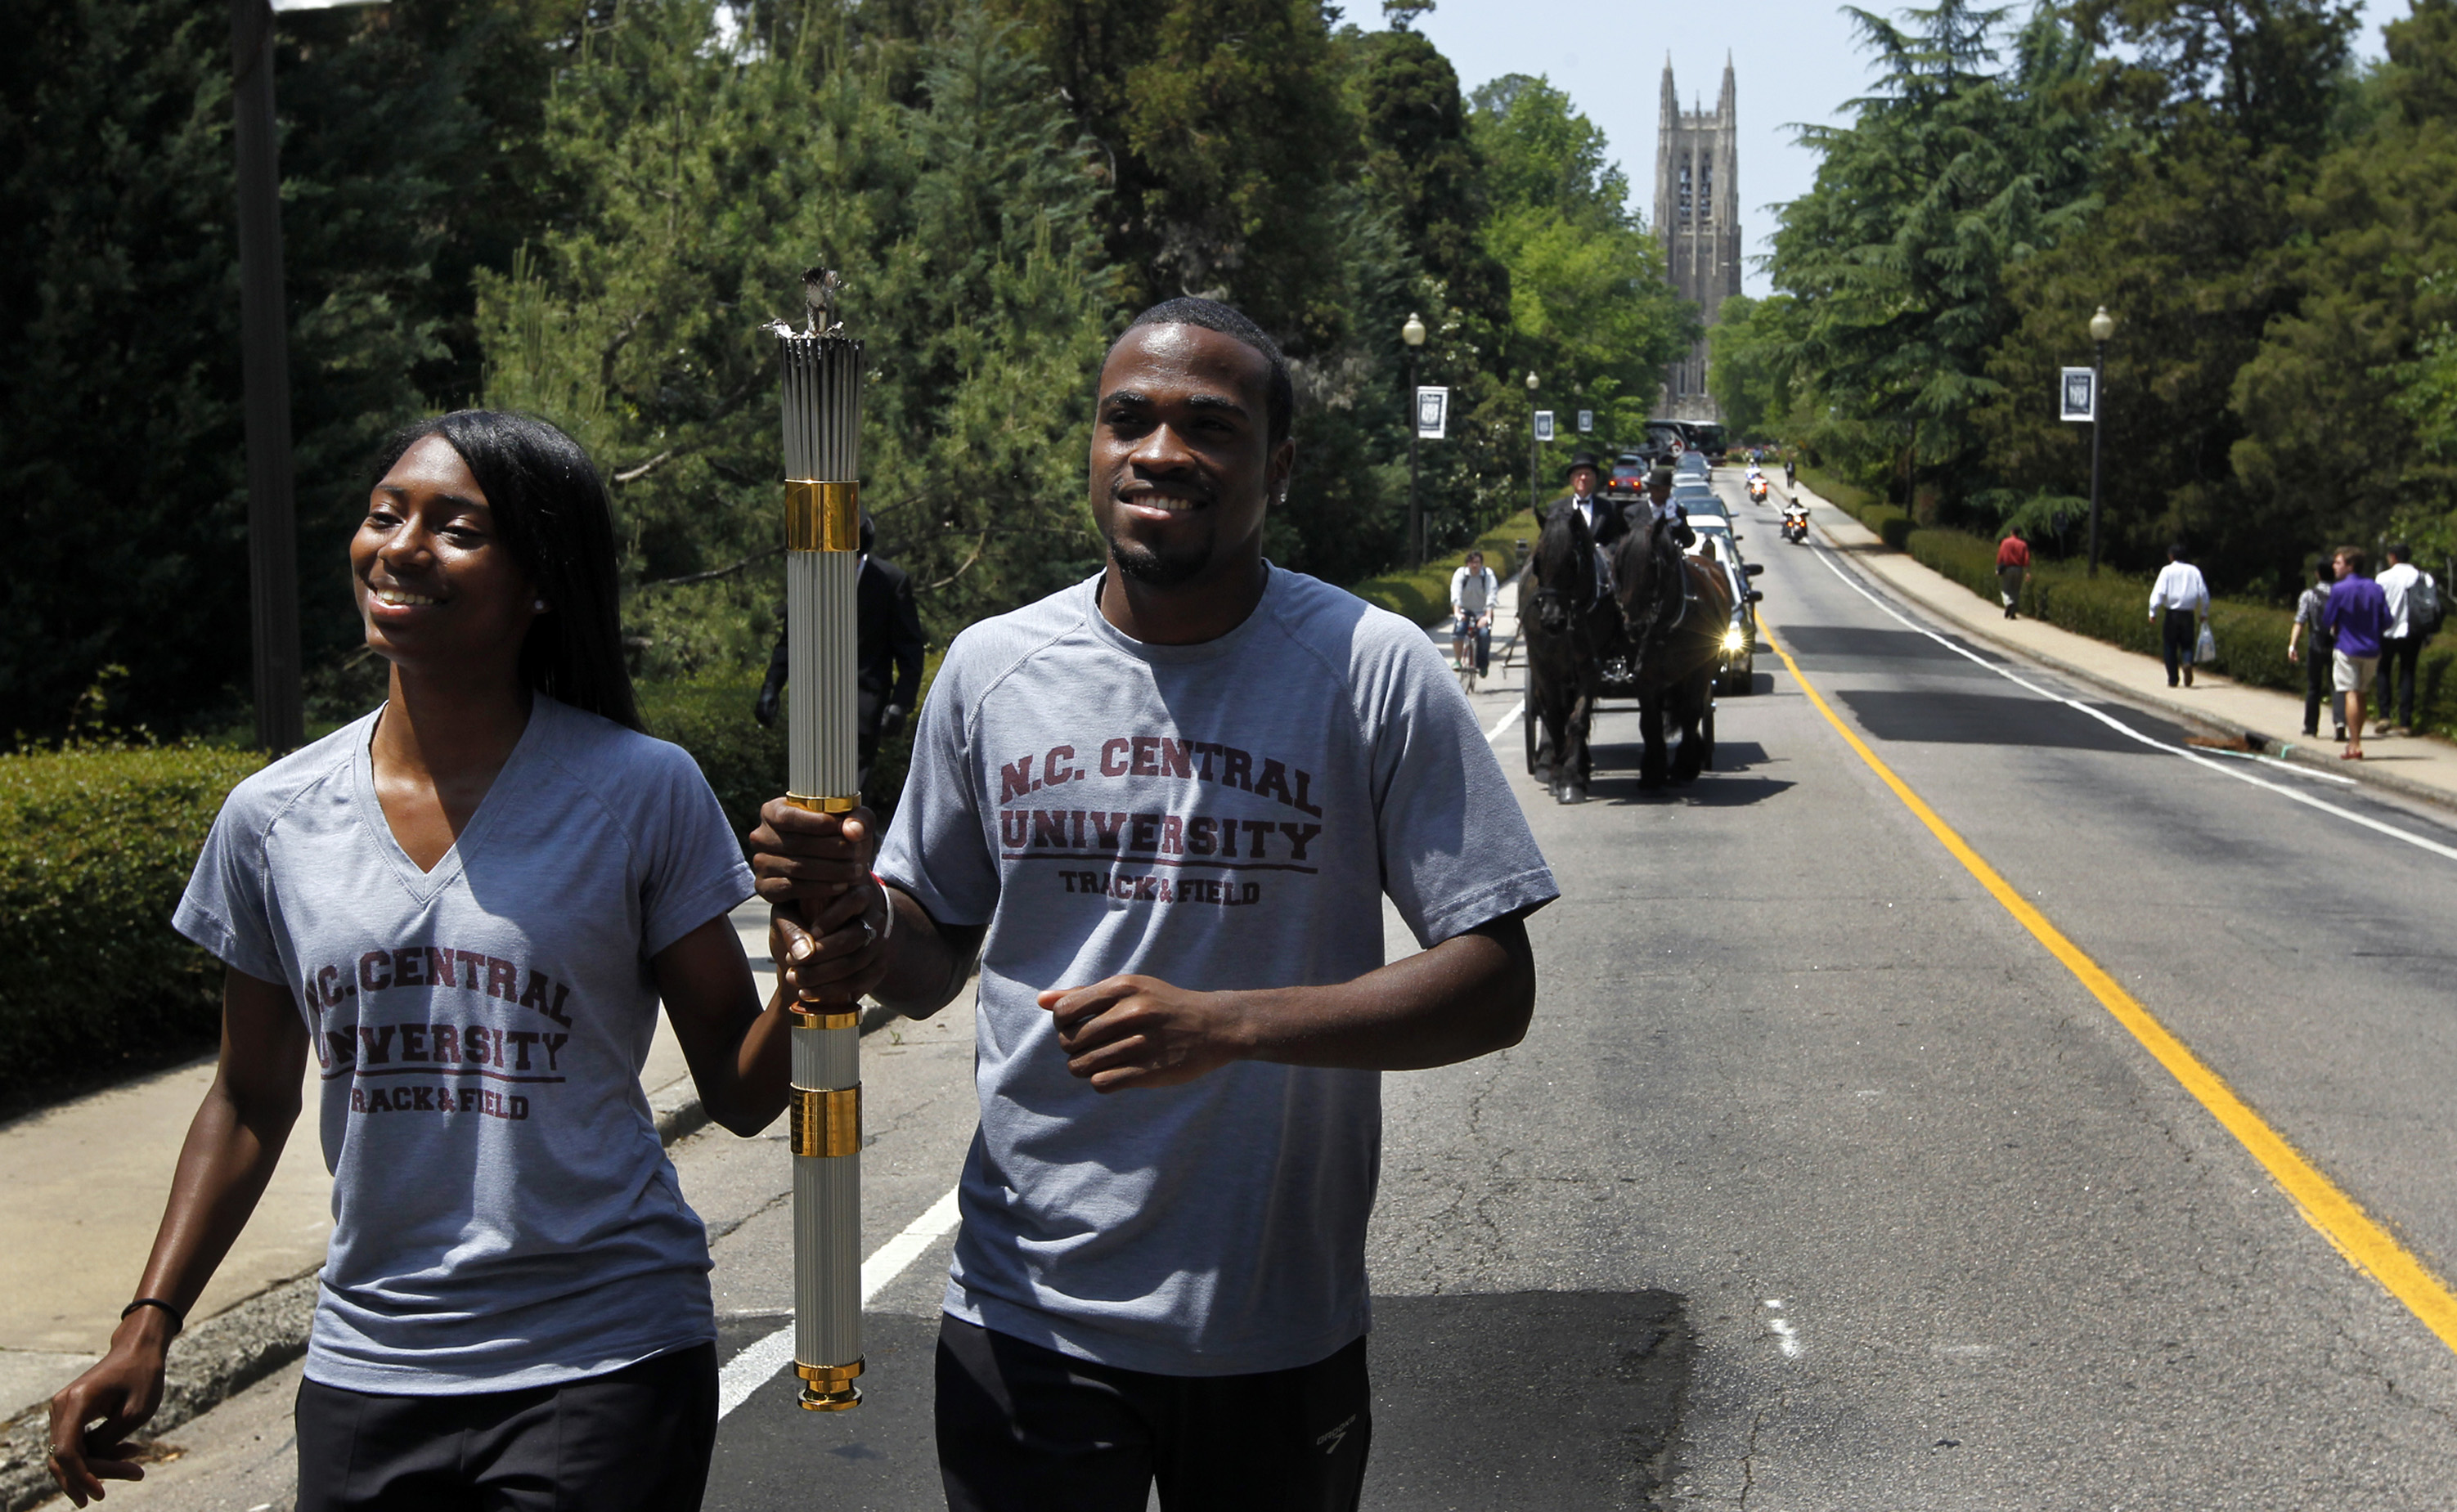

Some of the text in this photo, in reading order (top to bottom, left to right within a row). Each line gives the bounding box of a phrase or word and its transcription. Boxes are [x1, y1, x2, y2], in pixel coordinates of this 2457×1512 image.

[999, 736, 1323, 819] N.C. CENTRAL
[1000, 810, 1322, 861] UNIVERSITY
[359, 946, 573, 1030] CENTRAL
[320, 1023, 569, 1070] NVERSITY
